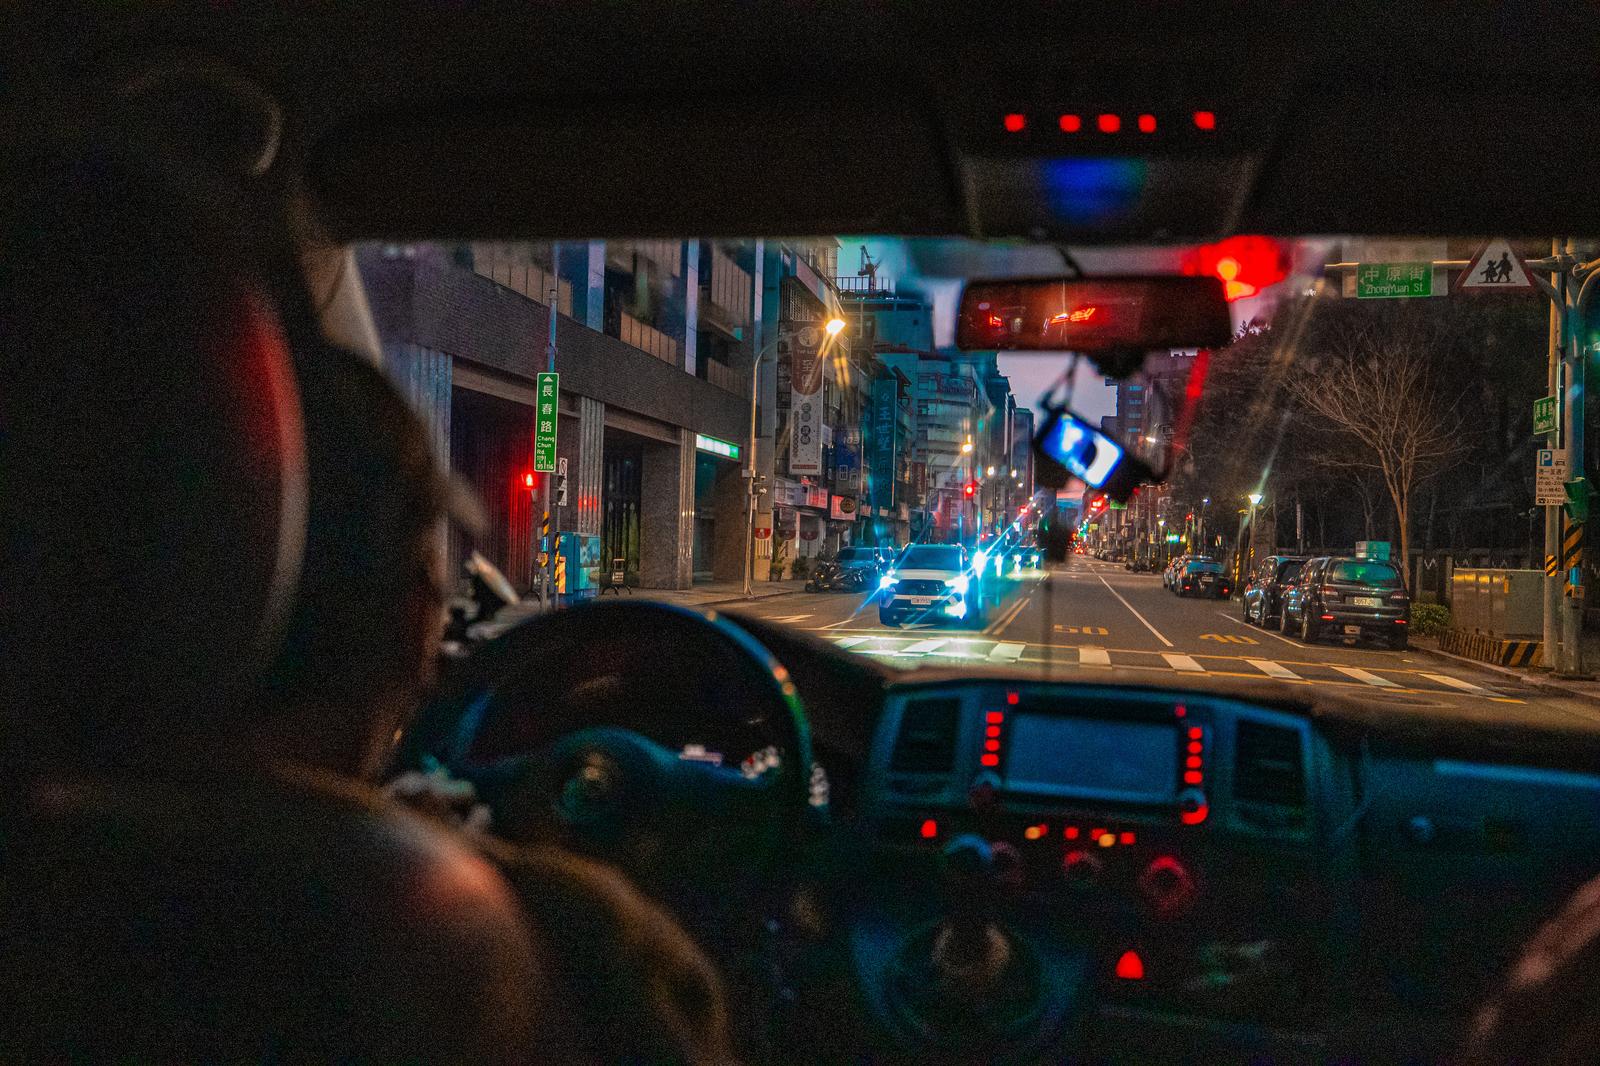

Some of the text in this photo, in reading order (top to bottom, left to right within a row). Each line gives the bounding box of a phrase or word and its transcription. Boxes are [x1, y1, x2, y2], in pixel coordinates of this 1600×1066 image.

[1365, 266, 1424, 282] 中原街
[1366, 284, 1410, 296] ZhongYuan
[541, 385, 553, 432] 長春路
[1053, 624, 1109, 635] 50
